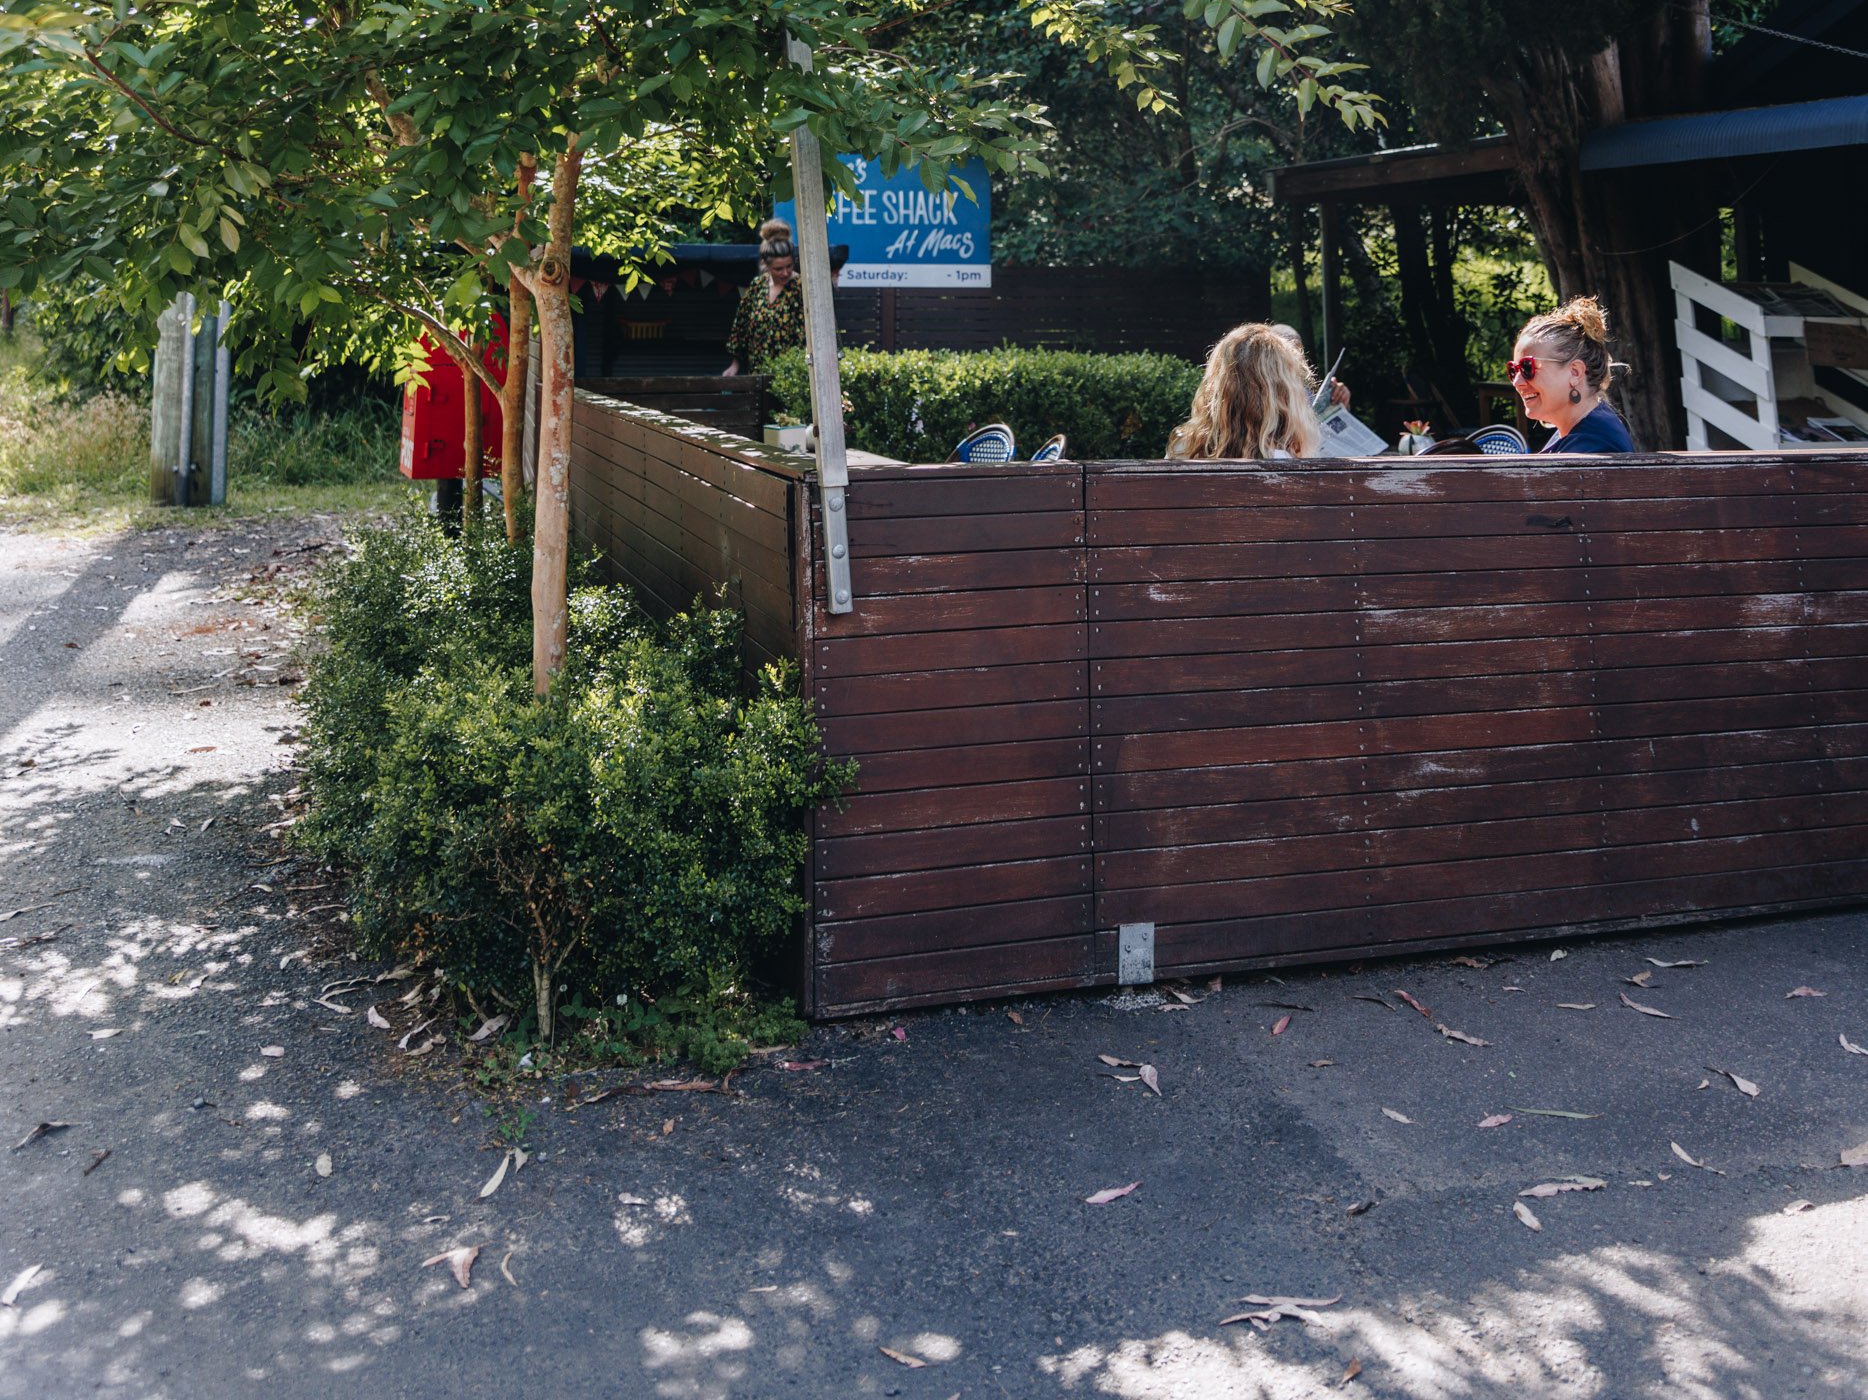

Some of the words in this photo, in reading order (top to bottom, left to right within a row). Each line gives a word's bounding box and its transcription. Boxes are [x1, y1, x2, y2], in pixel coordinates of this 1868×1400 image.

[882, 189, 959, 225] SHACK
[886, 229, 918, 258] At
[917, 228, 974, 258] Macs
[847, 269, 908, 282] Saturday:
[955, 270, 981, 282] 1pm
